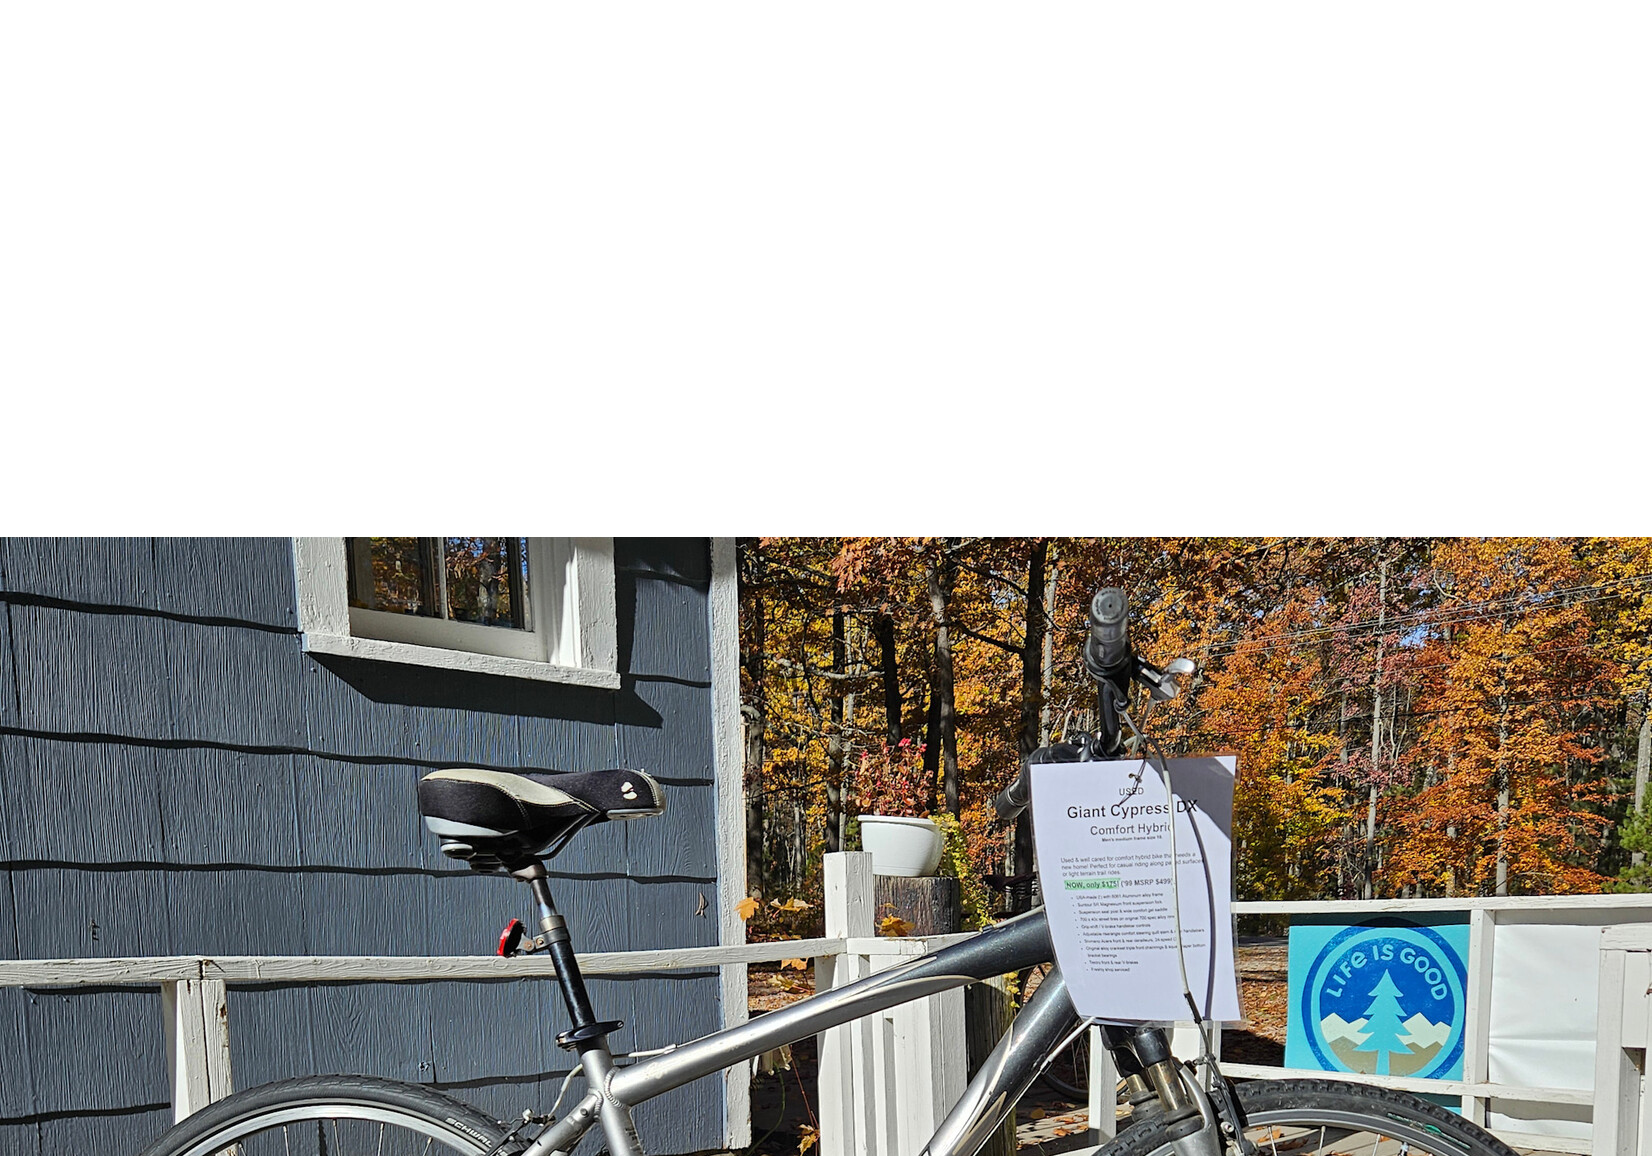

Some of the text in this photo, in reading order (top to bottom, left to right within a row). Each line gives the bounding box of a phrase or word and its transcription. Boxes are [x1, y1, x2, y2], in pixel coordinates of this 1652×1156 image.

[1118, 787, 1145, 796] USED
[1067, 799, 1198, 820] Giant Cypress DX
[1090, 824, 1135, 836] Comfort
[1066, 881, 1086, 889] NOW,
[1086, 881, 1100, 889] only
[1372, 943, 1395, 962] IS
[1399, 947, 1448, 1001] GOOD
